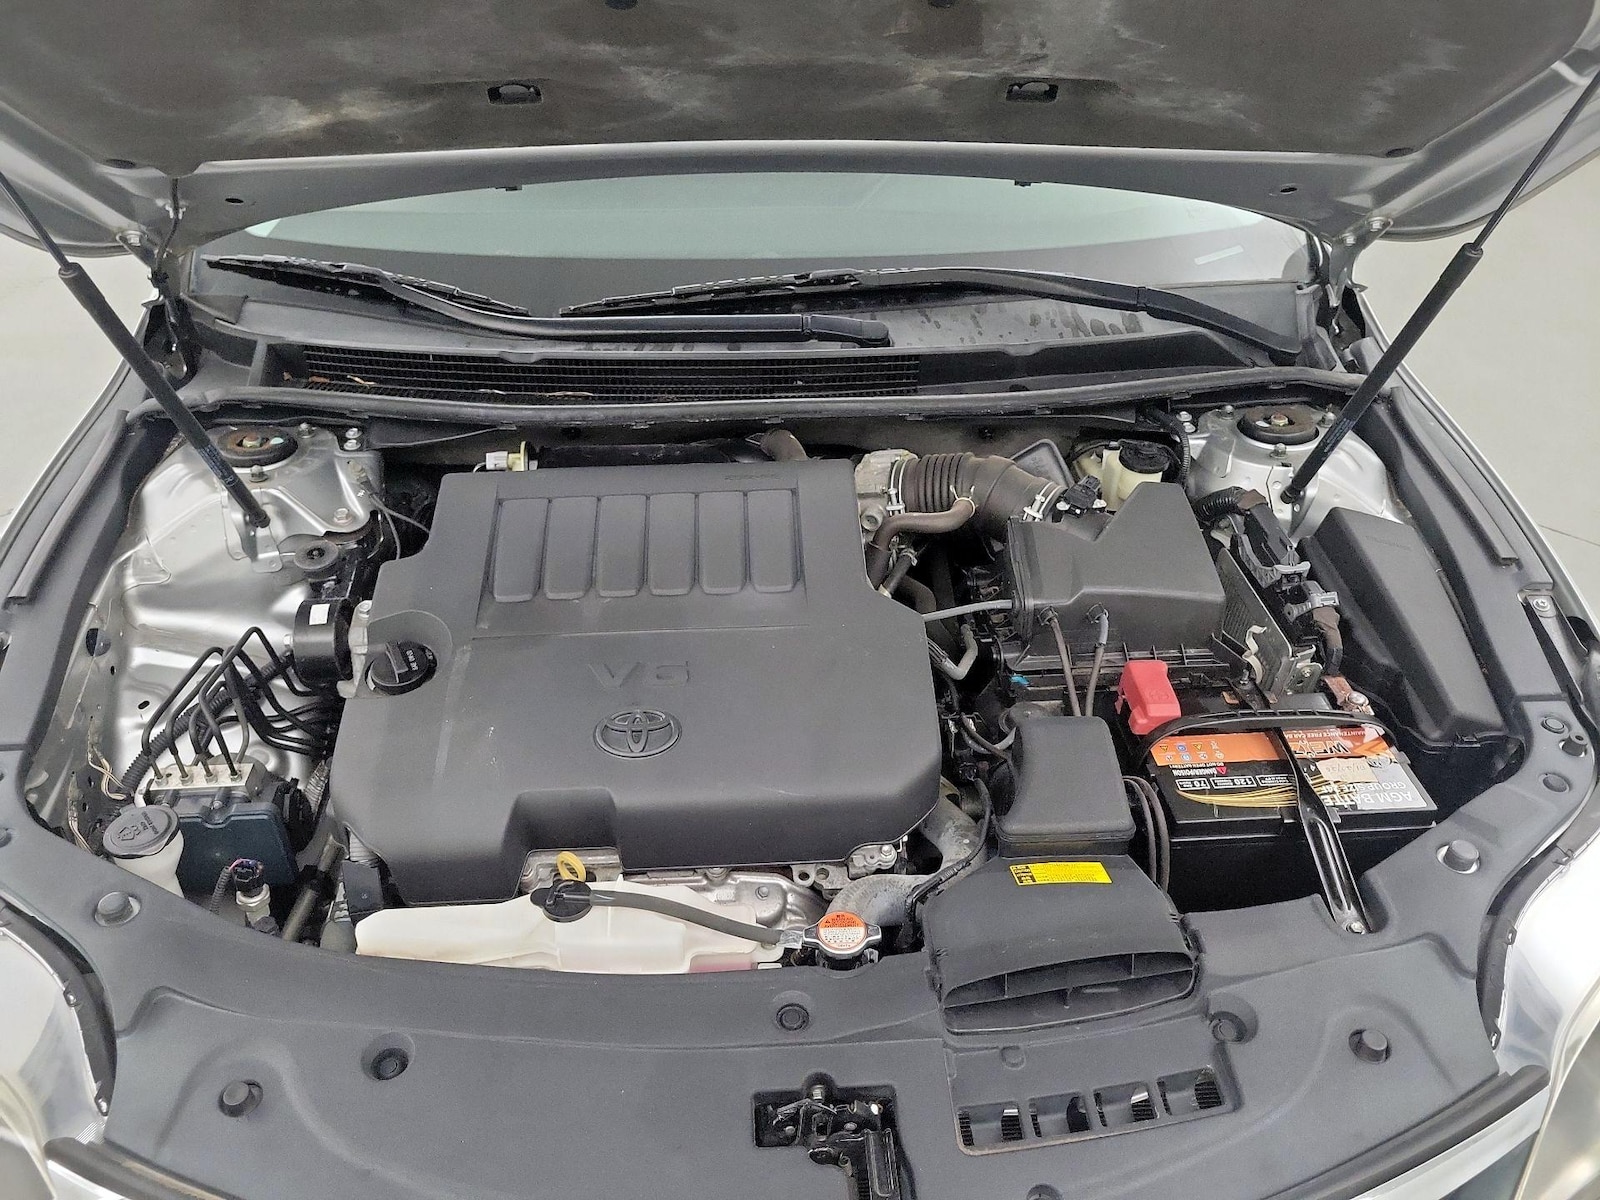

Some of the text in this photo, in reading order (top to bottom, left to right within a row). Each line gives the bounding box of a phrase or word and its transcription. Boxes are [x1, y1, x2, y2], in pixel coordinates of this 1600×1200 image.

[587, 660, 691, 690] V6
[1322, 730, 1367, 738] MAINTENANCE
[1290, 739, 1349, 758] WEIZ
[1172, 767, 1218, 777] DANGER/POISON
[1234, 777, 1252, 786] 120
[1367, 780, 1406, 791] GROUP
[1339, 783, 1366, 793] SIZE
[1320, 791, 1413, 807] AGM BATTE
